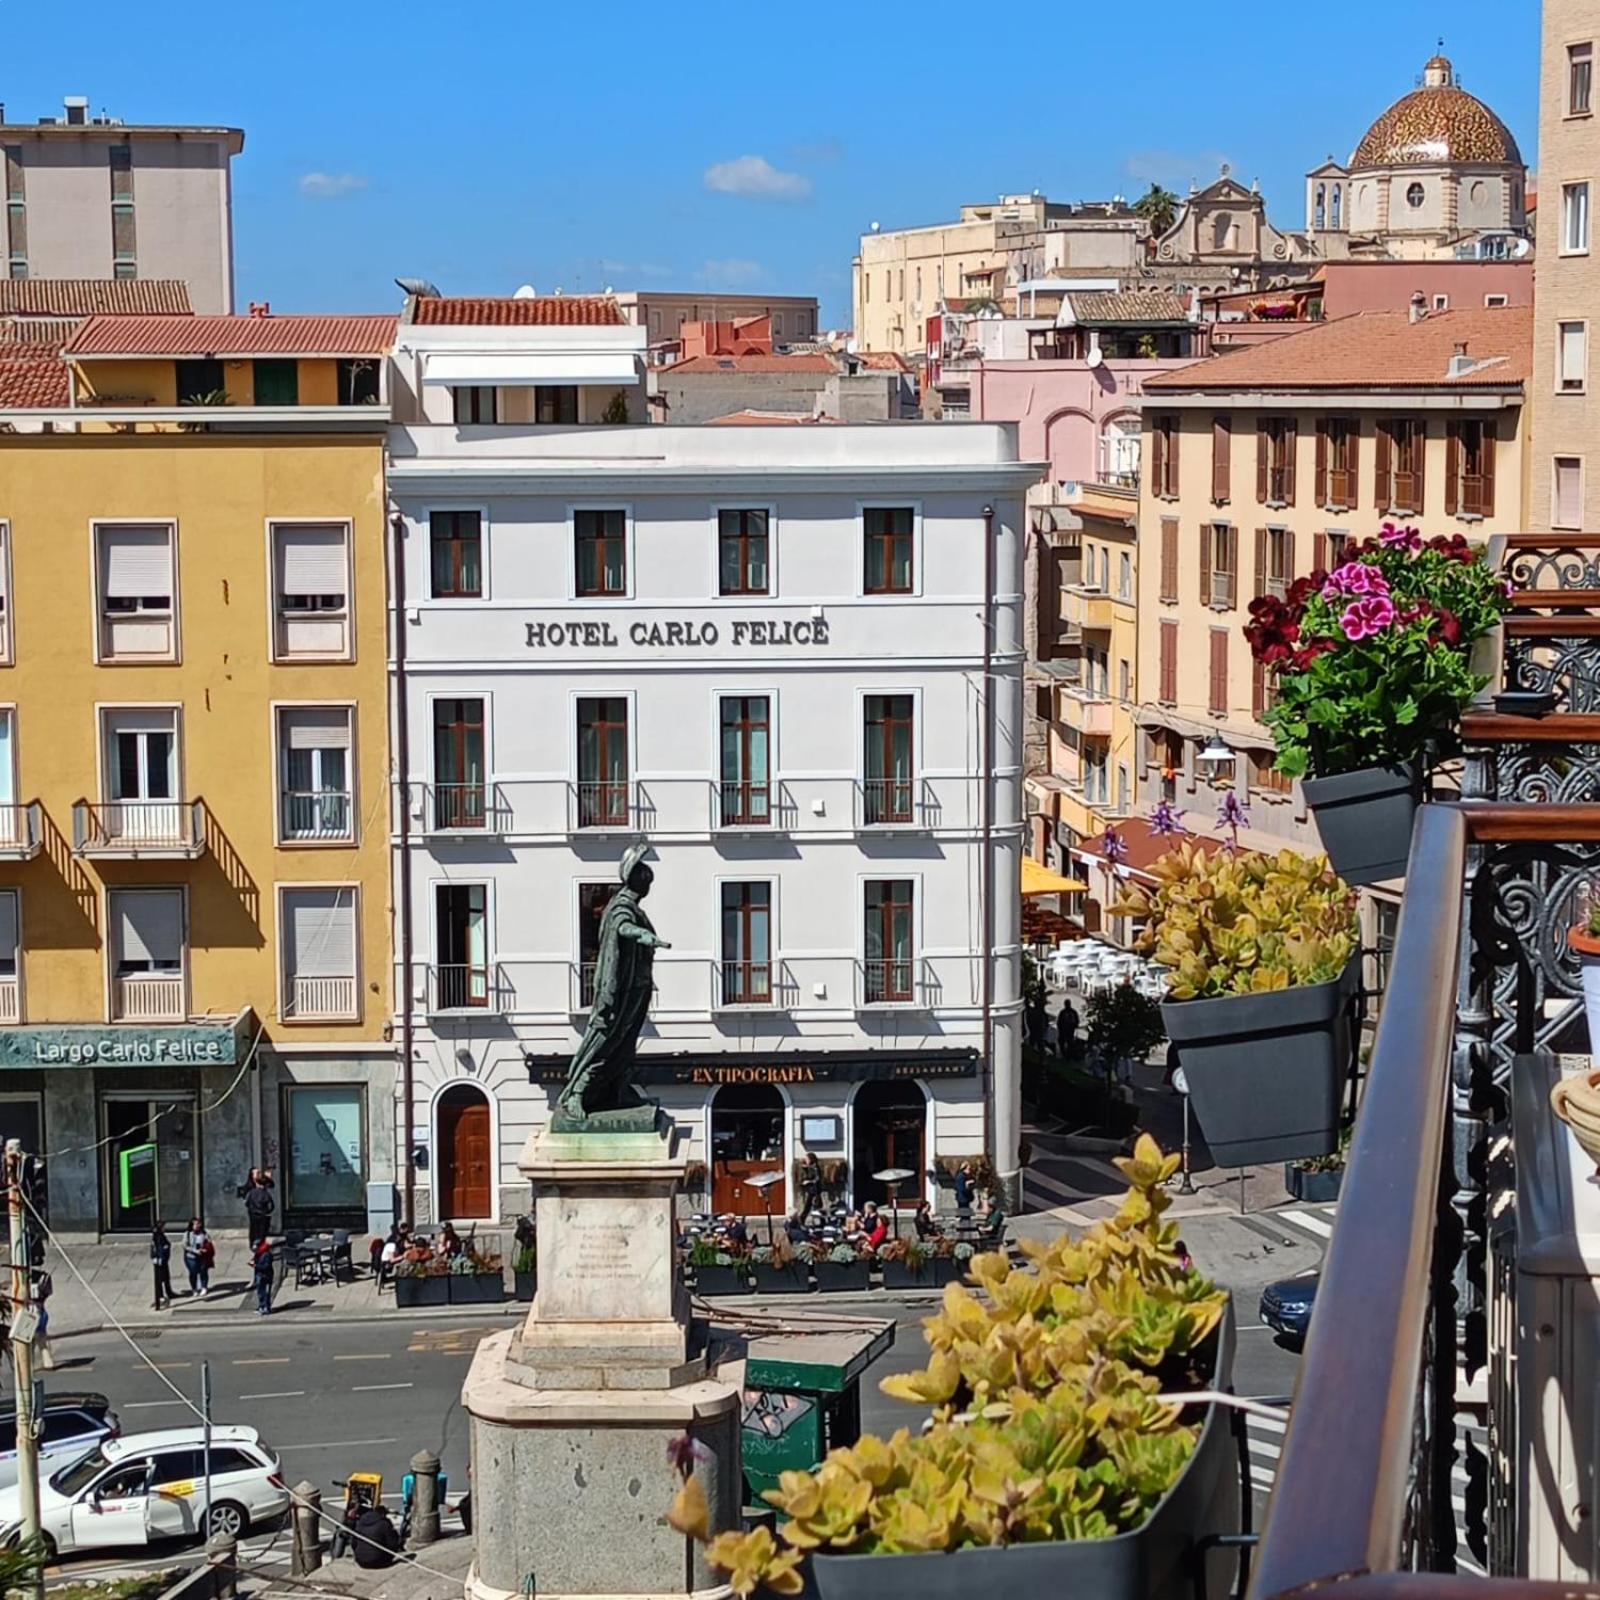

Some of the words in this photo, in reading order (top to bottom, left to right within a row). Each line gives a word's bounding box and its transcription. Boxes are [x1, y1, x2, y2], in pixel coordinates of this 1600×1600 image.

[526, 622, 618, 647] HOTEL
[629, 621, 719, 646] CARLO
[731, 618, 830, 646] FELICE
[36, 1041, 95, 1061] Largo
[98, 1039, 151, 1058] Carlo
[154, 1038, 220, 1056] Felice
[693, 1067, 713, 1082] EX
[715, 1067, 814, 1082] TIPOGRAFIA
